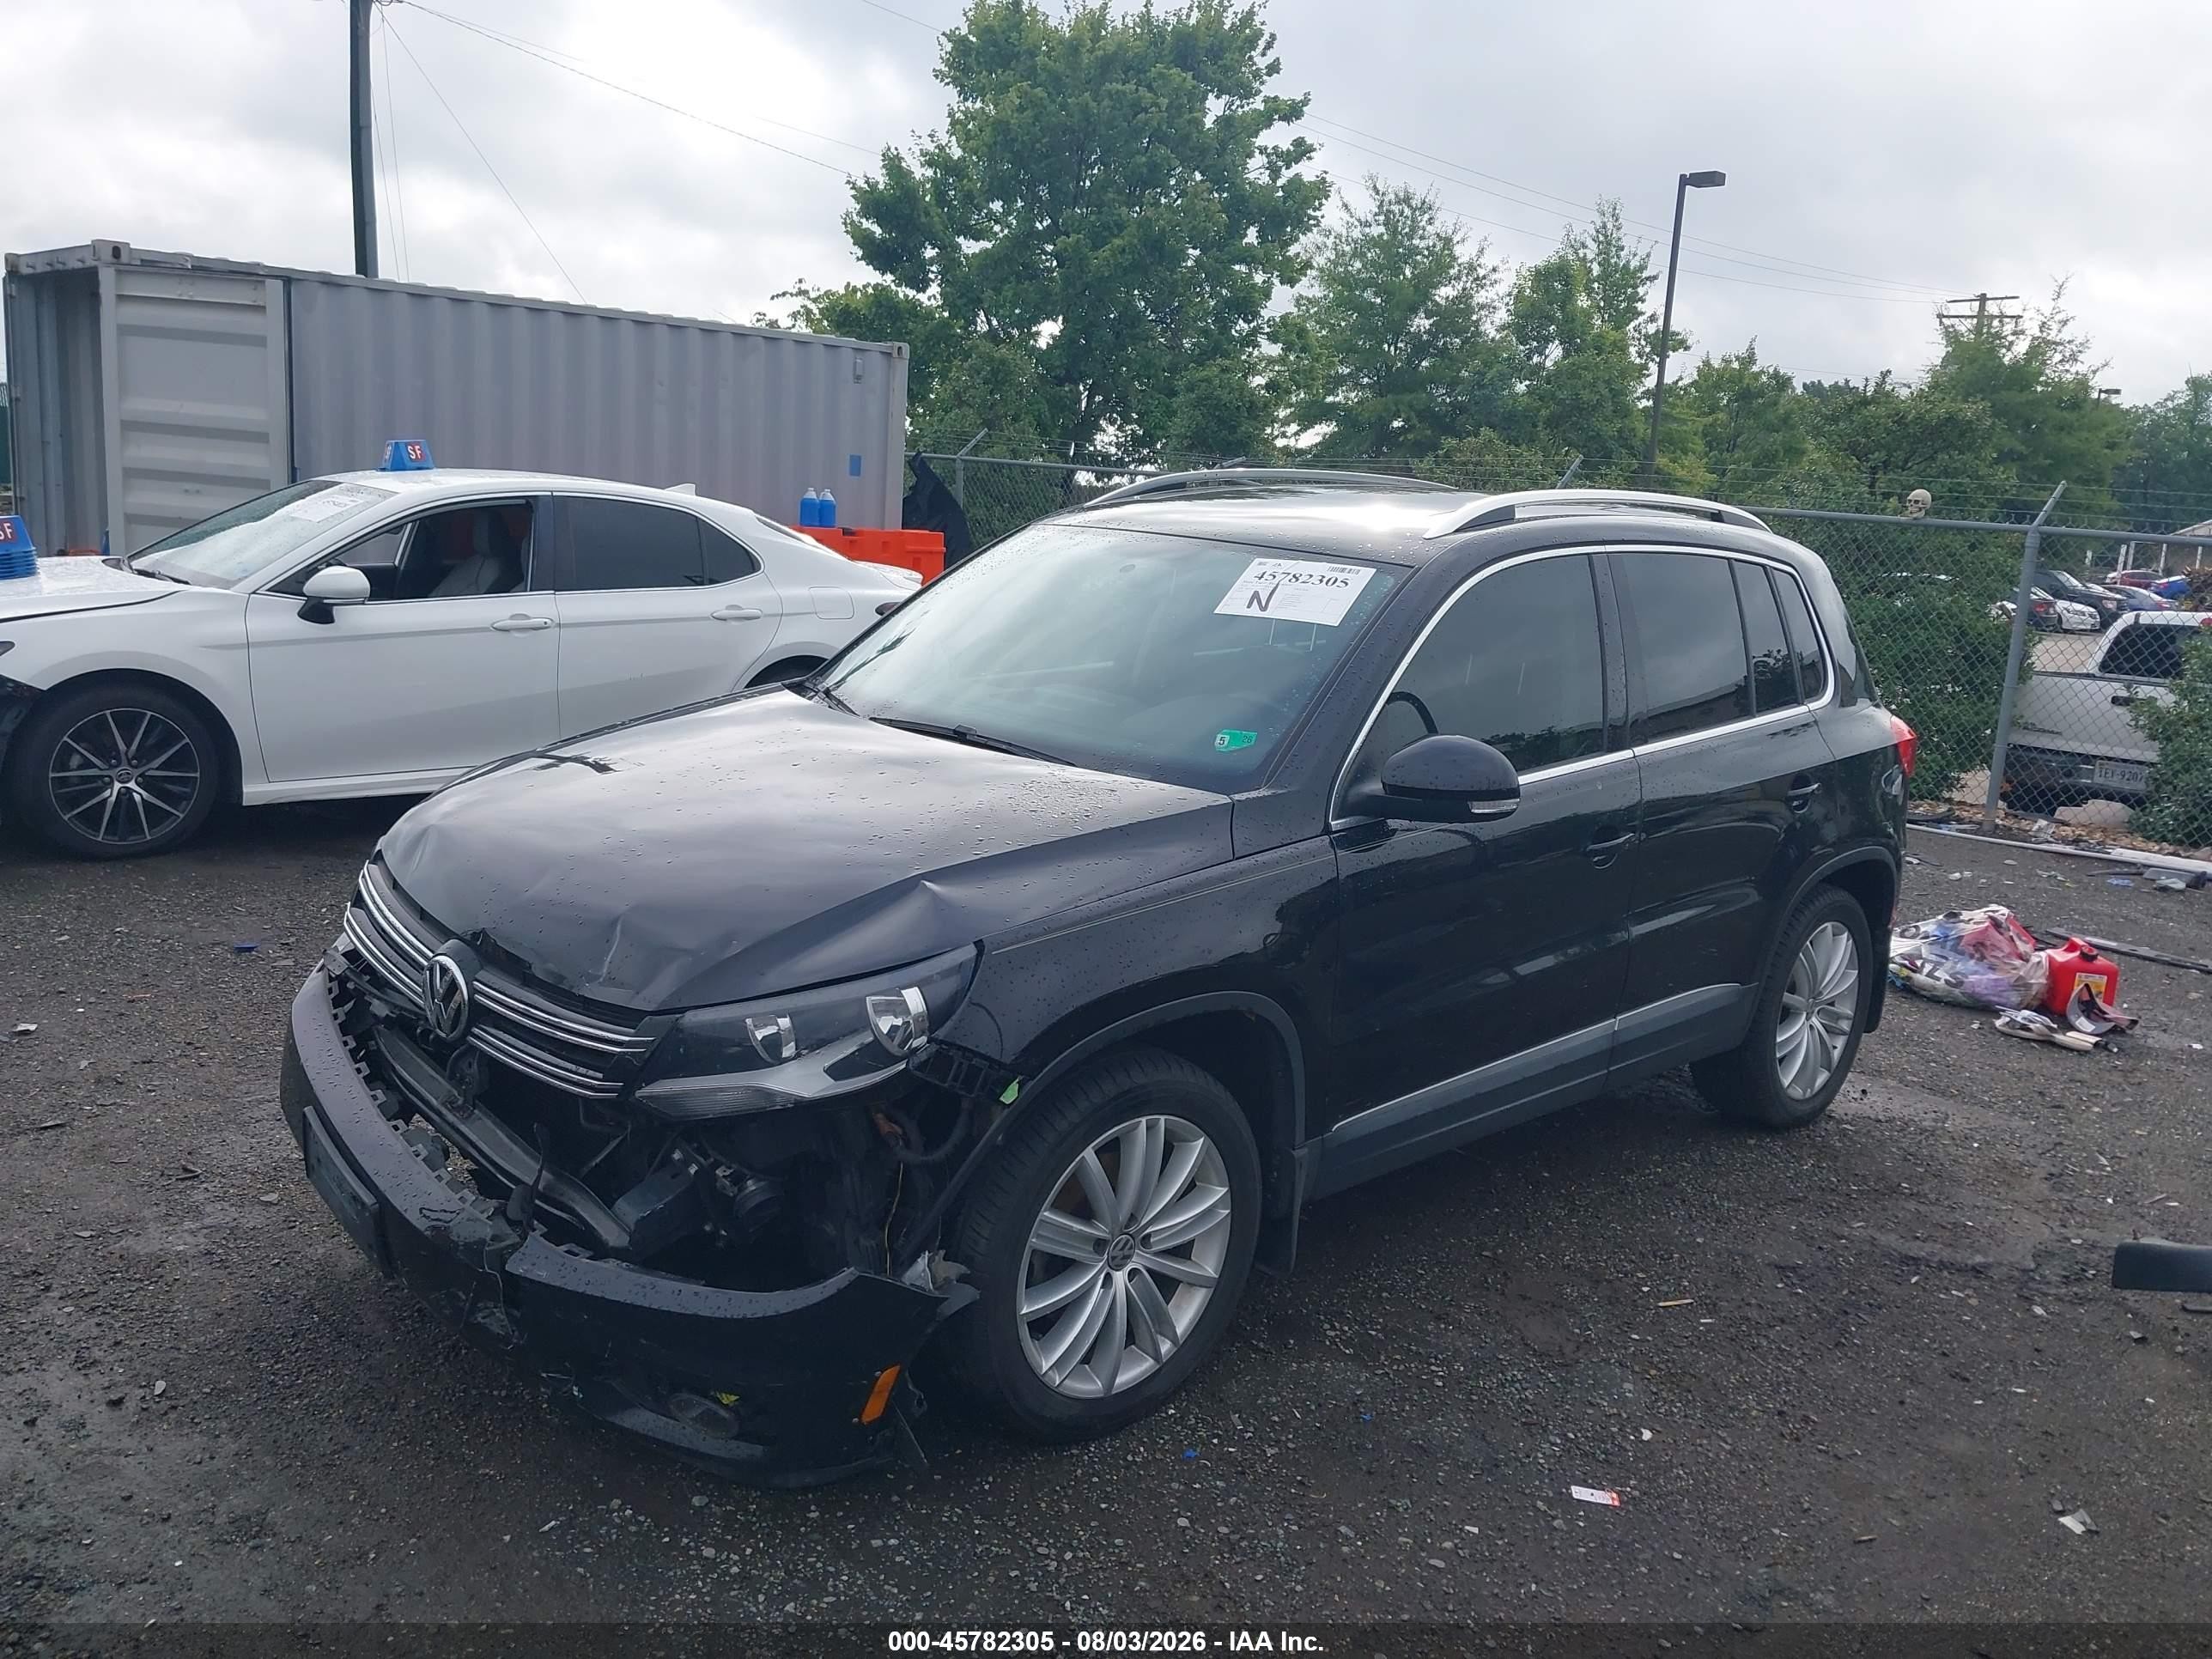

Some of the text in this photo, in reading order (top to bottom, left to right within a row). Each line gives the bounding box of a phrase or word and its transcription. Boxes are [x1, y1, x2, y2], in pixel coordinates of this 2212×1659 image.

[408, 445, 422, 459] SF
[1254, 570, 1351, 589] 45782305
[1246, 581, 1280, 612] N
[1218, 736, 1226, 745] 5
